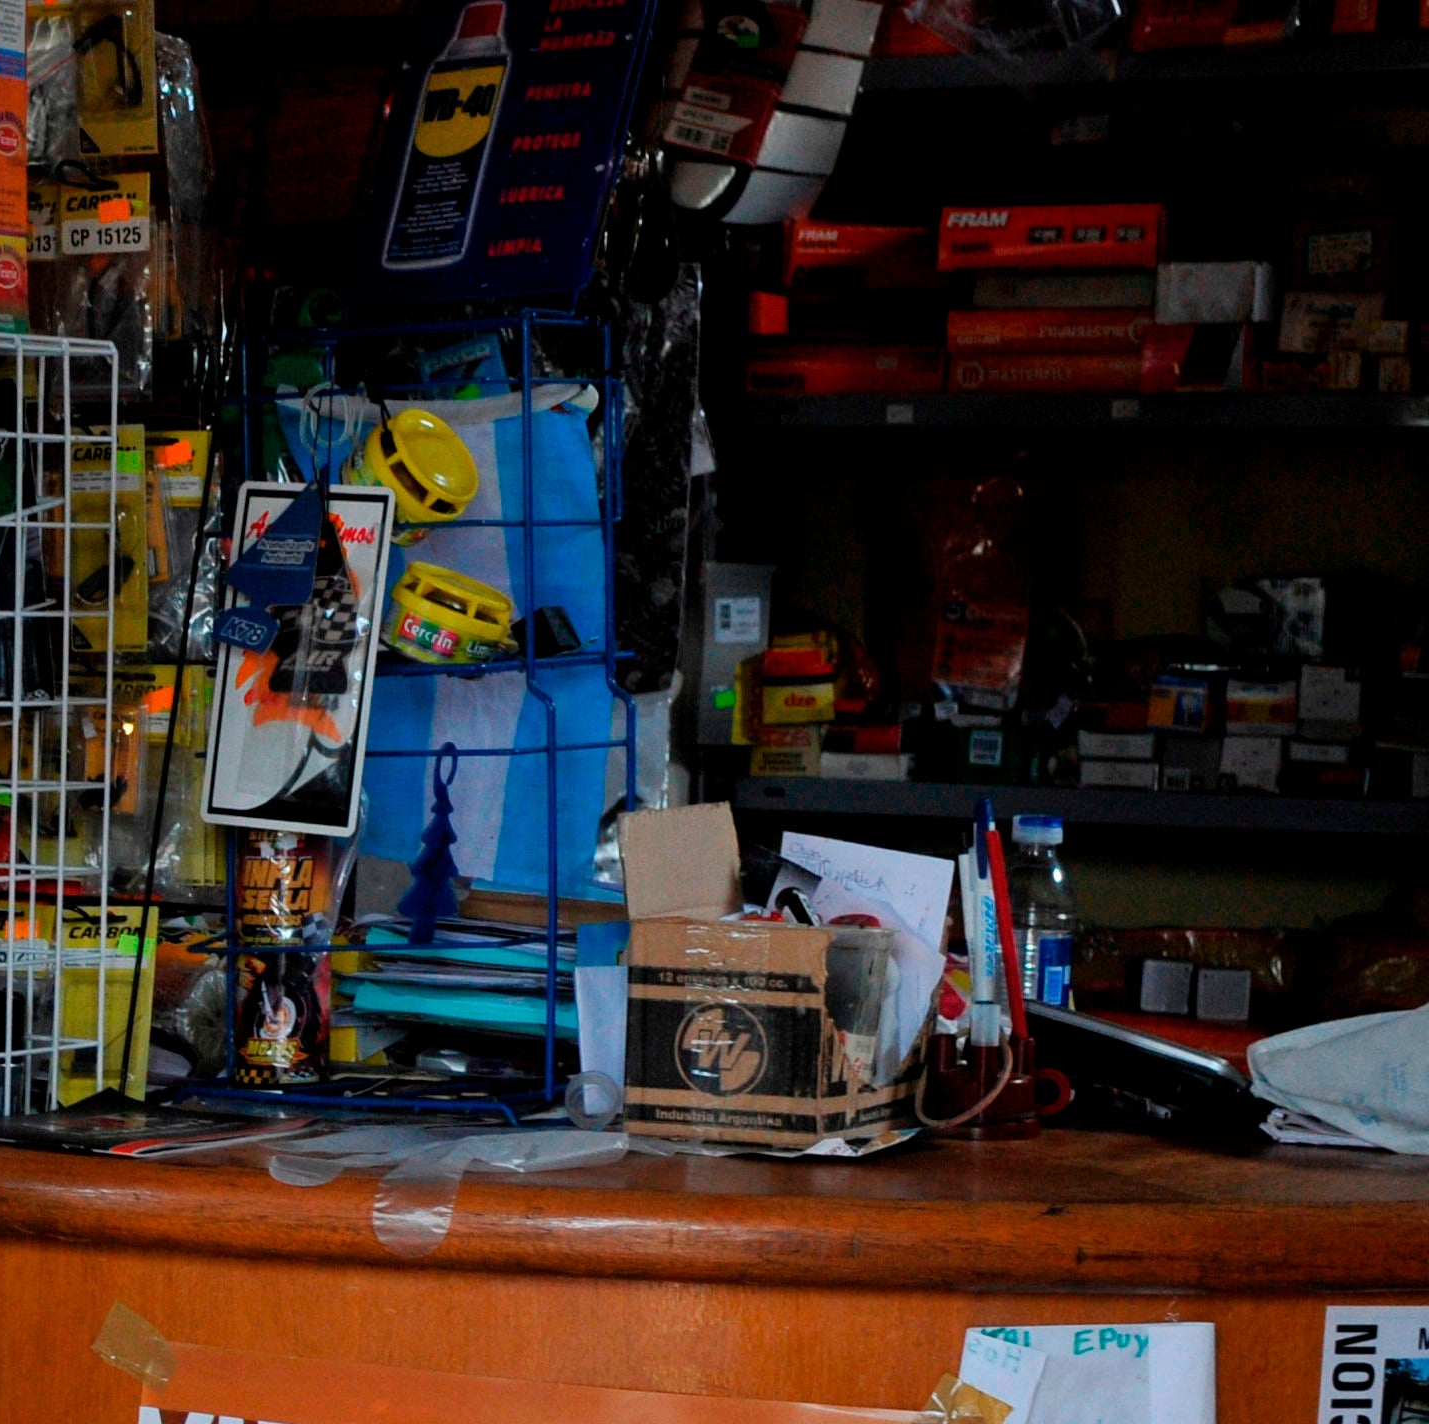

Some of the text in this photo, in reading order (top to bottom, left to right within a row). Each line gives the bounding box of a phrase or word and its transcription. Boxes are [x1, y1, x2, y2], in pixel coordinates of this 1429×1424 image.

[423, 83, 498, 123] WD-40
[946, 211, 1010, 229] FRAM
[70, 226, 142, 248] CP 15125
[221, 615, 268, 645] K78
[403, 616, 454, 649] Cercrin
[658, 972, 674, 983] 12
[654, 1108, 783, 1128] Industria Argentina
